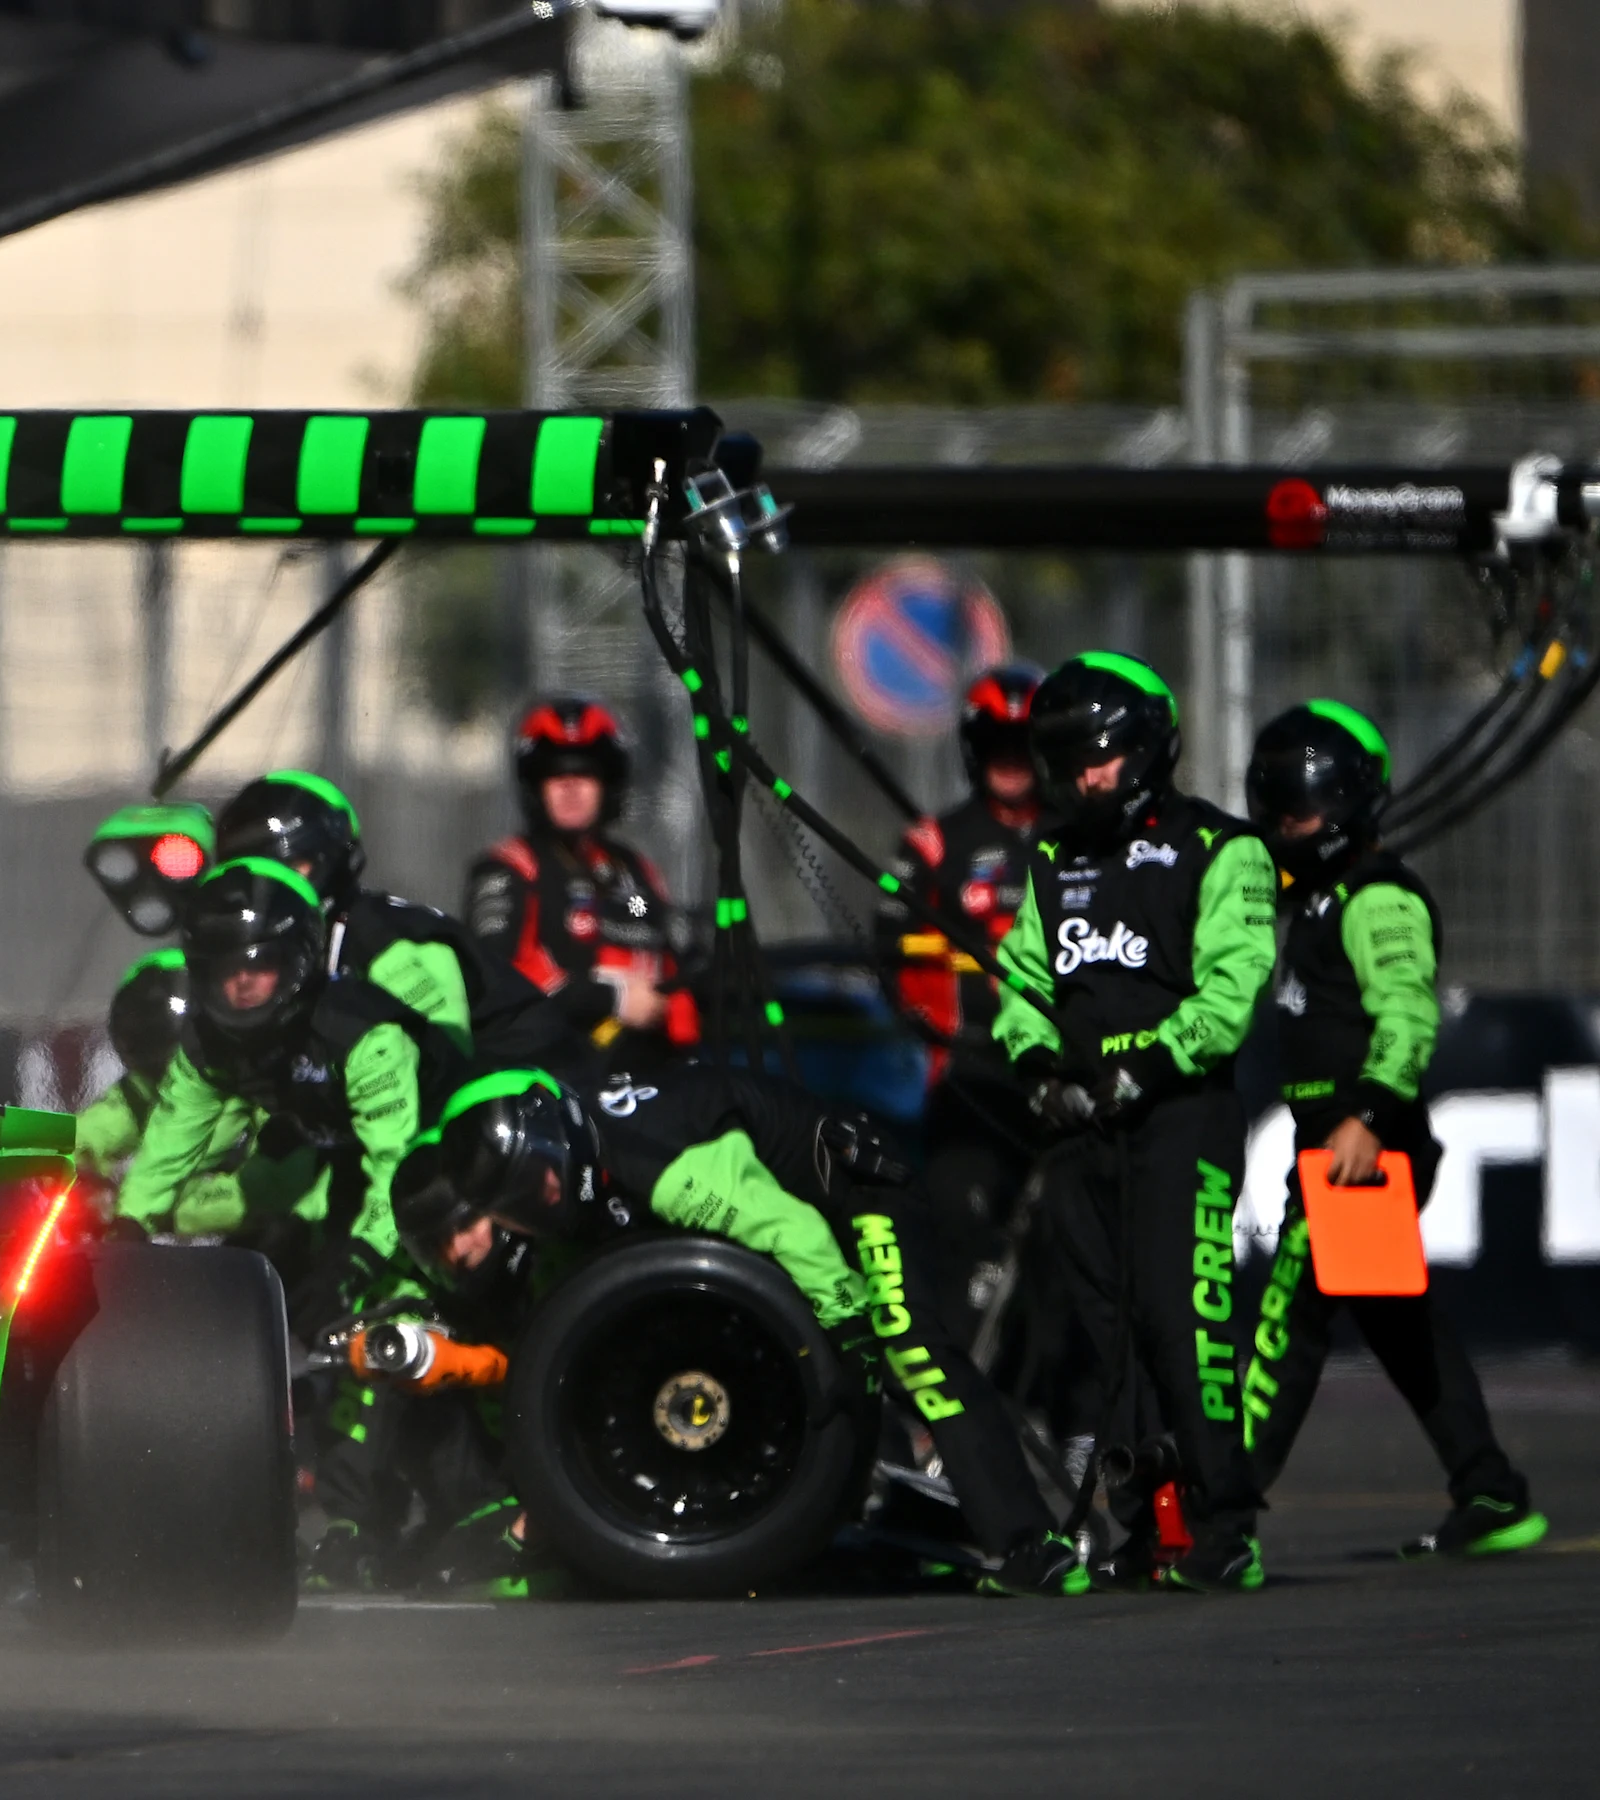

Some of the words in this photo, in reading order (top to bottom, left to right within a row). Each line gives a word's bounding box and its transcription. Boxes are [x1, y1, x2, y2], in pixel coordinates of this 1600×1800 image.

[1126, 838, 1180, 870] Stake
[1055, 917, 1150, 975] Stake
[1102, 1033, 1133, 1056] PIT
[852, 1213, 912, 1338] CREW
[1192, 1157, 1234, 1322] CREW
[884, 1345, 966, 1422] PIT
[1195, 1328, 1236, 1422] PIT
[1241, 1354, 1280, 1452] IT
